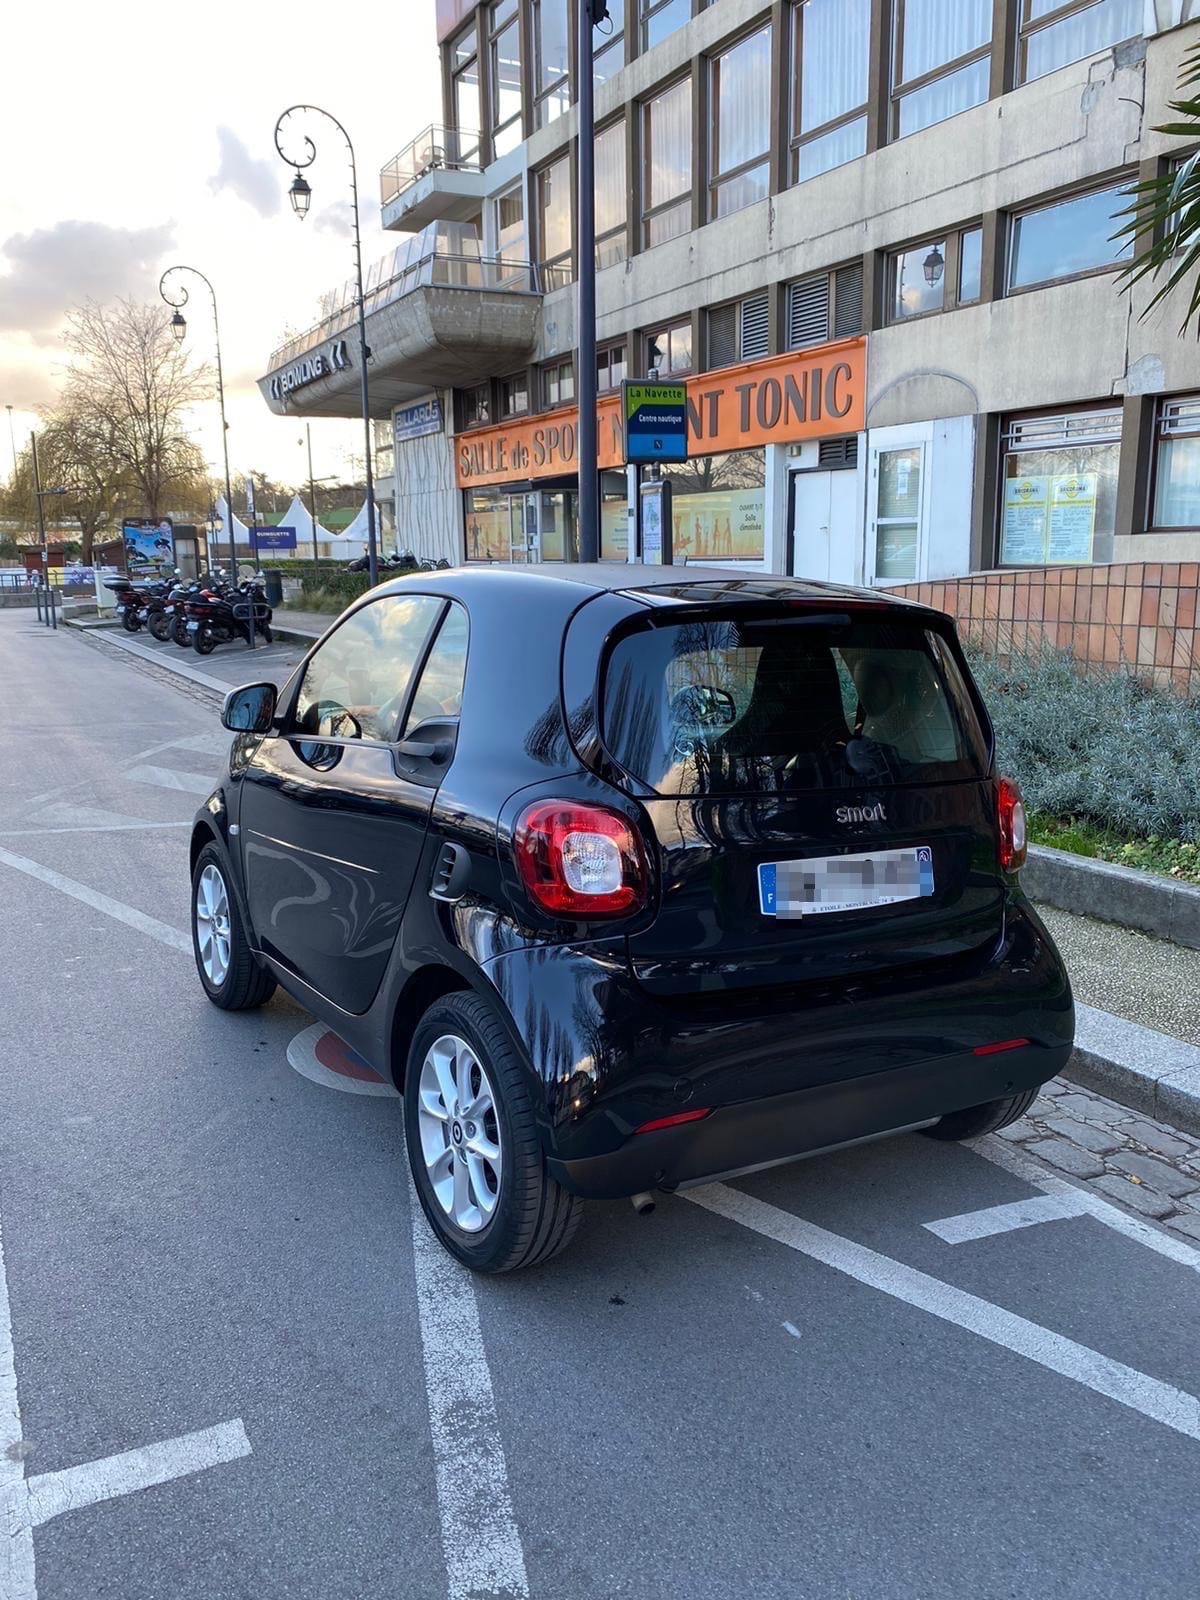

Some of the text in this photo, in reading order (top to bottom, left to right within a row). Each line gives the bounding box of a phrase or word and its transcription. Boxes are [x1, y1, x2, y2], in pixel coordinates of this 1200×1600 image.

[281, 355, 323, 392] BOWLING
[630, 388, 682, 399] La Navette
[460, 436, 508, 478] SALLE
[511, 440, 529, 470] de
[735, 361, 853, 433] TONIC
[638, 414, 682, 425] Centre nautique
[836, 803, 887, 824] smart
[768, 893, 774, 904] F
